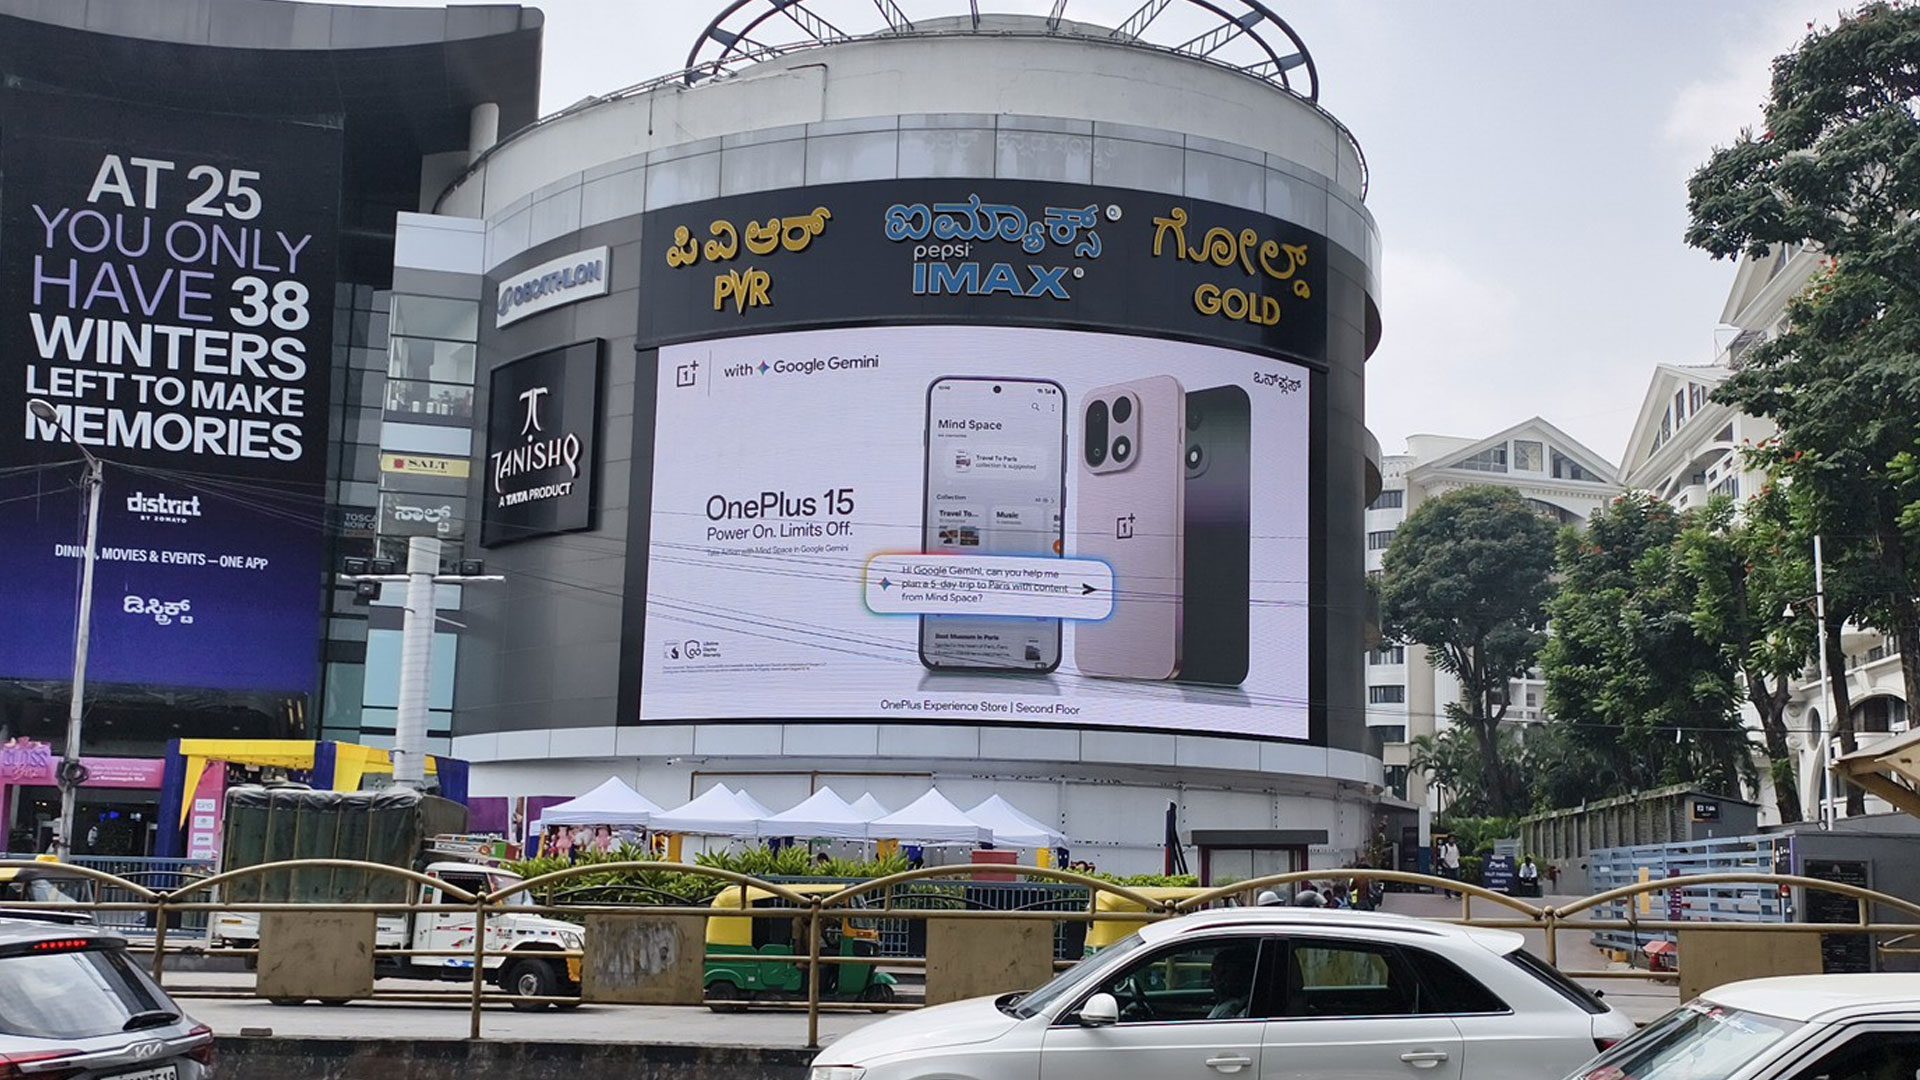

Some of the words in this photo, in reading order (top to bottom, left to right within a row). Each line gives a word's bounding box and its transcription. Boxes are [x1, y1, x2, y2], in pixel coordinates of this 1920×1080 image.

[87, 154, 175, 209] AT
[186, 165, 262, 220] 25
[32, 204, 151, 257] YOU
[165, 220, 312, 273] ONLY
[914, 242, 970, 261] pepsi
[33, 255, 215, 322] HAVE
[230, 276, 310, 330] 38
[513, 259, 603, 306] DECATHLON
[714, 266, 771, 315] PVR
[913, 262, 1070, 299] IMAX
[1194, 283, 1281, 326] GOLD
[29, 312, 308, 381] WINTERS
[724, 363, 753, 378] with
[773, 358, 825, 375] Google
[828, 354, 879, 370] Gemini
[26, 365, 124, 401] LEFT
[131, 375, 185, 406] TO
[191, 380, 304, 417] MAKE
[25, 401, 303, 461] MEMORIES
[938, 419, 966, 429] Mind
[968, 420, 1002, 431] Space
[408, 460, 448, 469] SALT
[127, 491, 201, 516] district
[498, 496, 505, 507] A
[505, 490, 529, 505] TATA
[528, 482, 572, 501] PRODUCT
[706, 491, 816, 521] OnePlus
[823, 488, 854, 515] 15
[996, 511, 1019, 519] Music
[707, 527, 750, 541] Power
[753, 524, 776, 539] On.
[780, 523, 822, 538] Limits
[826, 521, 853, 536] Off.
[55, 544, 99, 560] DININ,
[102, 547, 147, 562] MOVIES
[149, 550, 158, 562] &
[161, 551, 206, 565] EVENTS
[220, 556, 243, 568] ONE
[245, 557, 268, 570] APP
[801, 545, 824, 554] Google
[825, 544, 849, 552] Gemini
[902, 566, 911, 574] Hi
[914, 565, 947, 576] Google
[1004, 569, 1022, 578] you
[1023, 569, 1043, 579] help
[902, 593, 924, 602] from
[925, 593, 948, 602] Mind
[949, 594, 983, 604] Space?
[959, 580, 974, 591] trip
[976, 581, 987, 589] to
[988, 580, 1010, 590] Paris
[1012, 582, 1032, 592] with
[1034, 583, 1068, 593] content
[880, 699, 922, 710] OnePlus
[924, 700, 978, 713] Experience
[980, 701, 1007, 712] Store
[1016, 702, 1053, 714] Second
[1056, 704, 1080, 715] Floor
